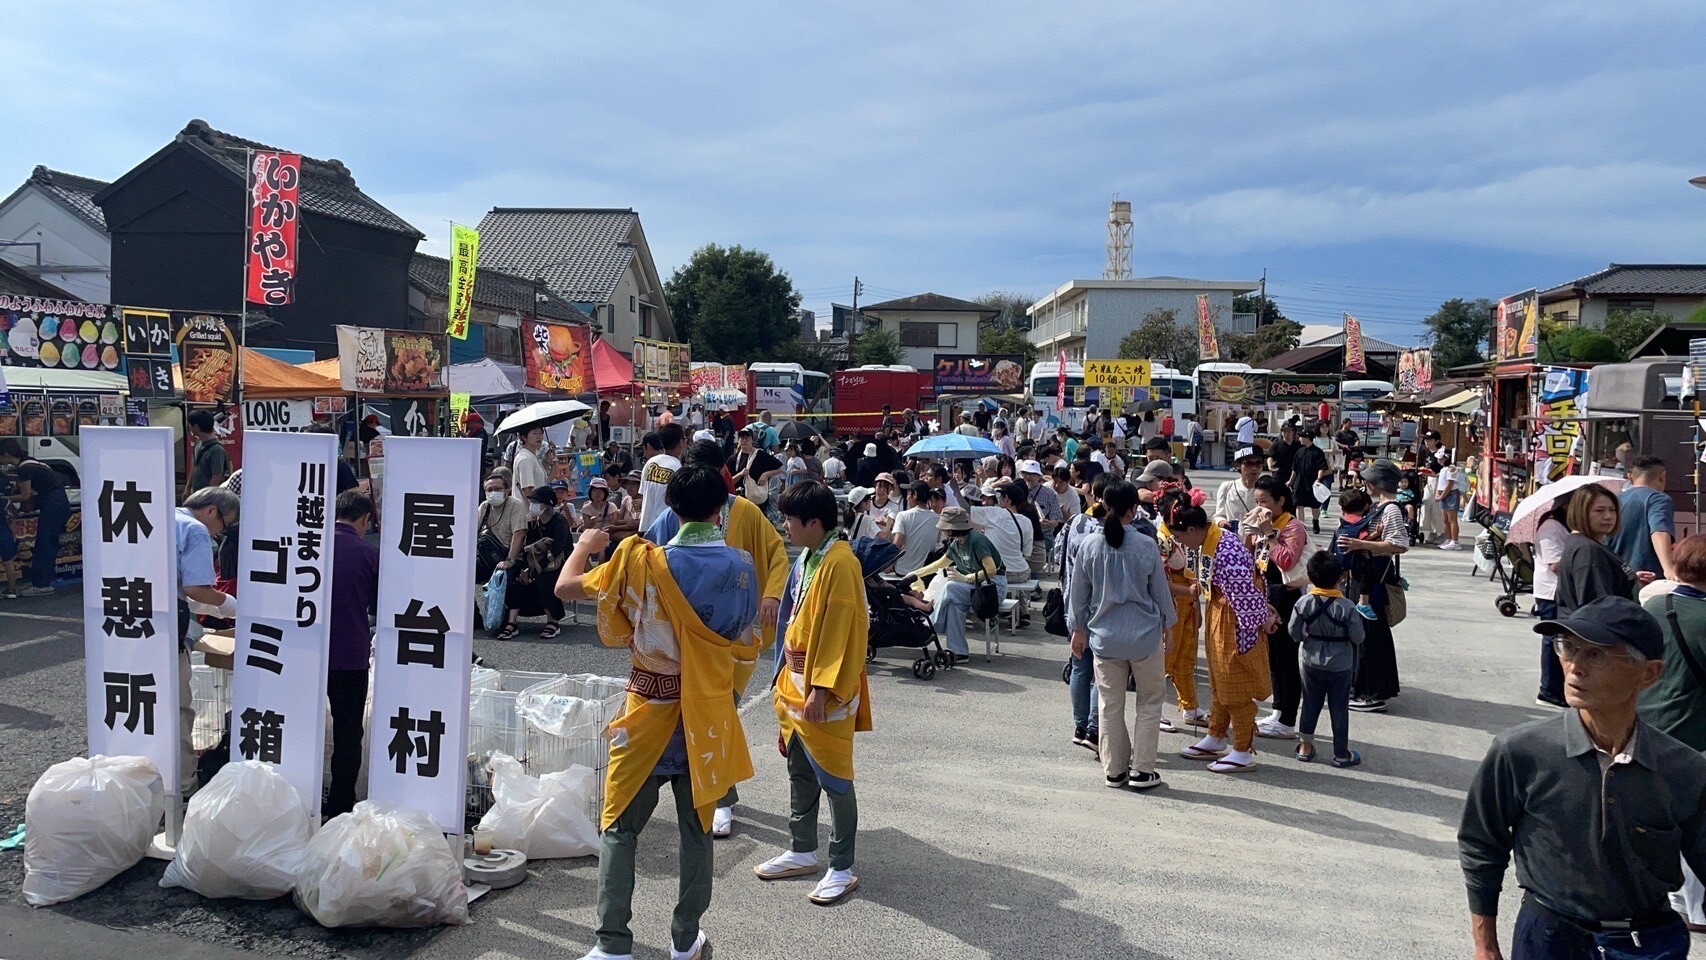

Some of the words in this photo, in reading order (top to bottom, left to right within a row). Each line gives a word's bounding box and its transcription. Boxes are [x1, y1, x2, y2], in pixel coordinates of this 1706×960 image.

[252, 156, 299, 305] いかやき
[127, 323, 170, 346] いか
[183, 317, 227, 331] いか焼き
[190, 332, 207, 340] Grilled
[207, 333, 222, 341] squid
[131, 366, 170, 390] 焼き
[936, 358, 991, 376] ケバブ
[1088, 363, 1145, 375] 大粒たこ焼
[246, 400, 291, 427] LONG
[1545, 399, 1581, 481] チュロス
[295, 463, 325, 627] 川越まつり
[98, 479, 157, 736] 休憩所
[387, 492, 456, 778] 屋台村
[239, 535, 292, 764] ゴミ箱
